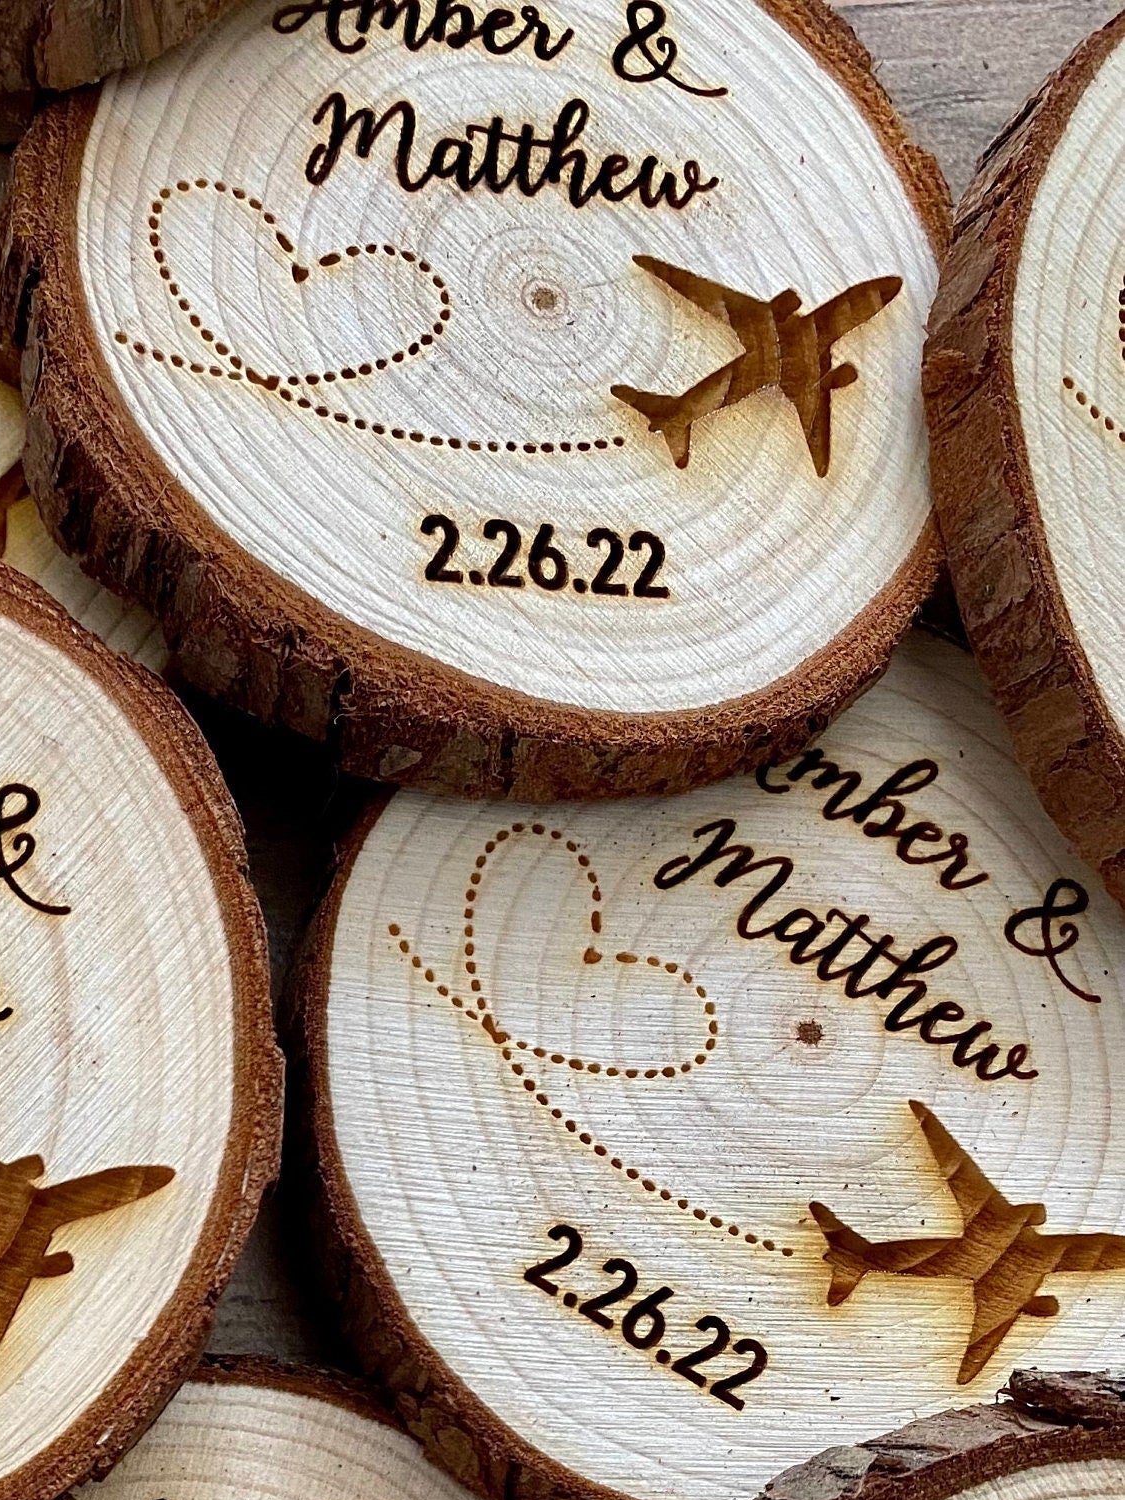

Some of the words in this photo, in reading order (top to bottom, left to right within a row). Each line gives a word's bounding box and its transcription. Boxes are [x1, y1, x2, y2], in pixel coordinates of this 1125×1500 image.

[612, 0, 729, 97] &
[304, 92, 720, 210] Matthew
[420, 514, 670, 599] 2.26.22
[654, 818, 1038, 1080] Matthew
[1004, 878, 1101, 1003] &
[523, 1225, 768, 1411] 2.26.22
